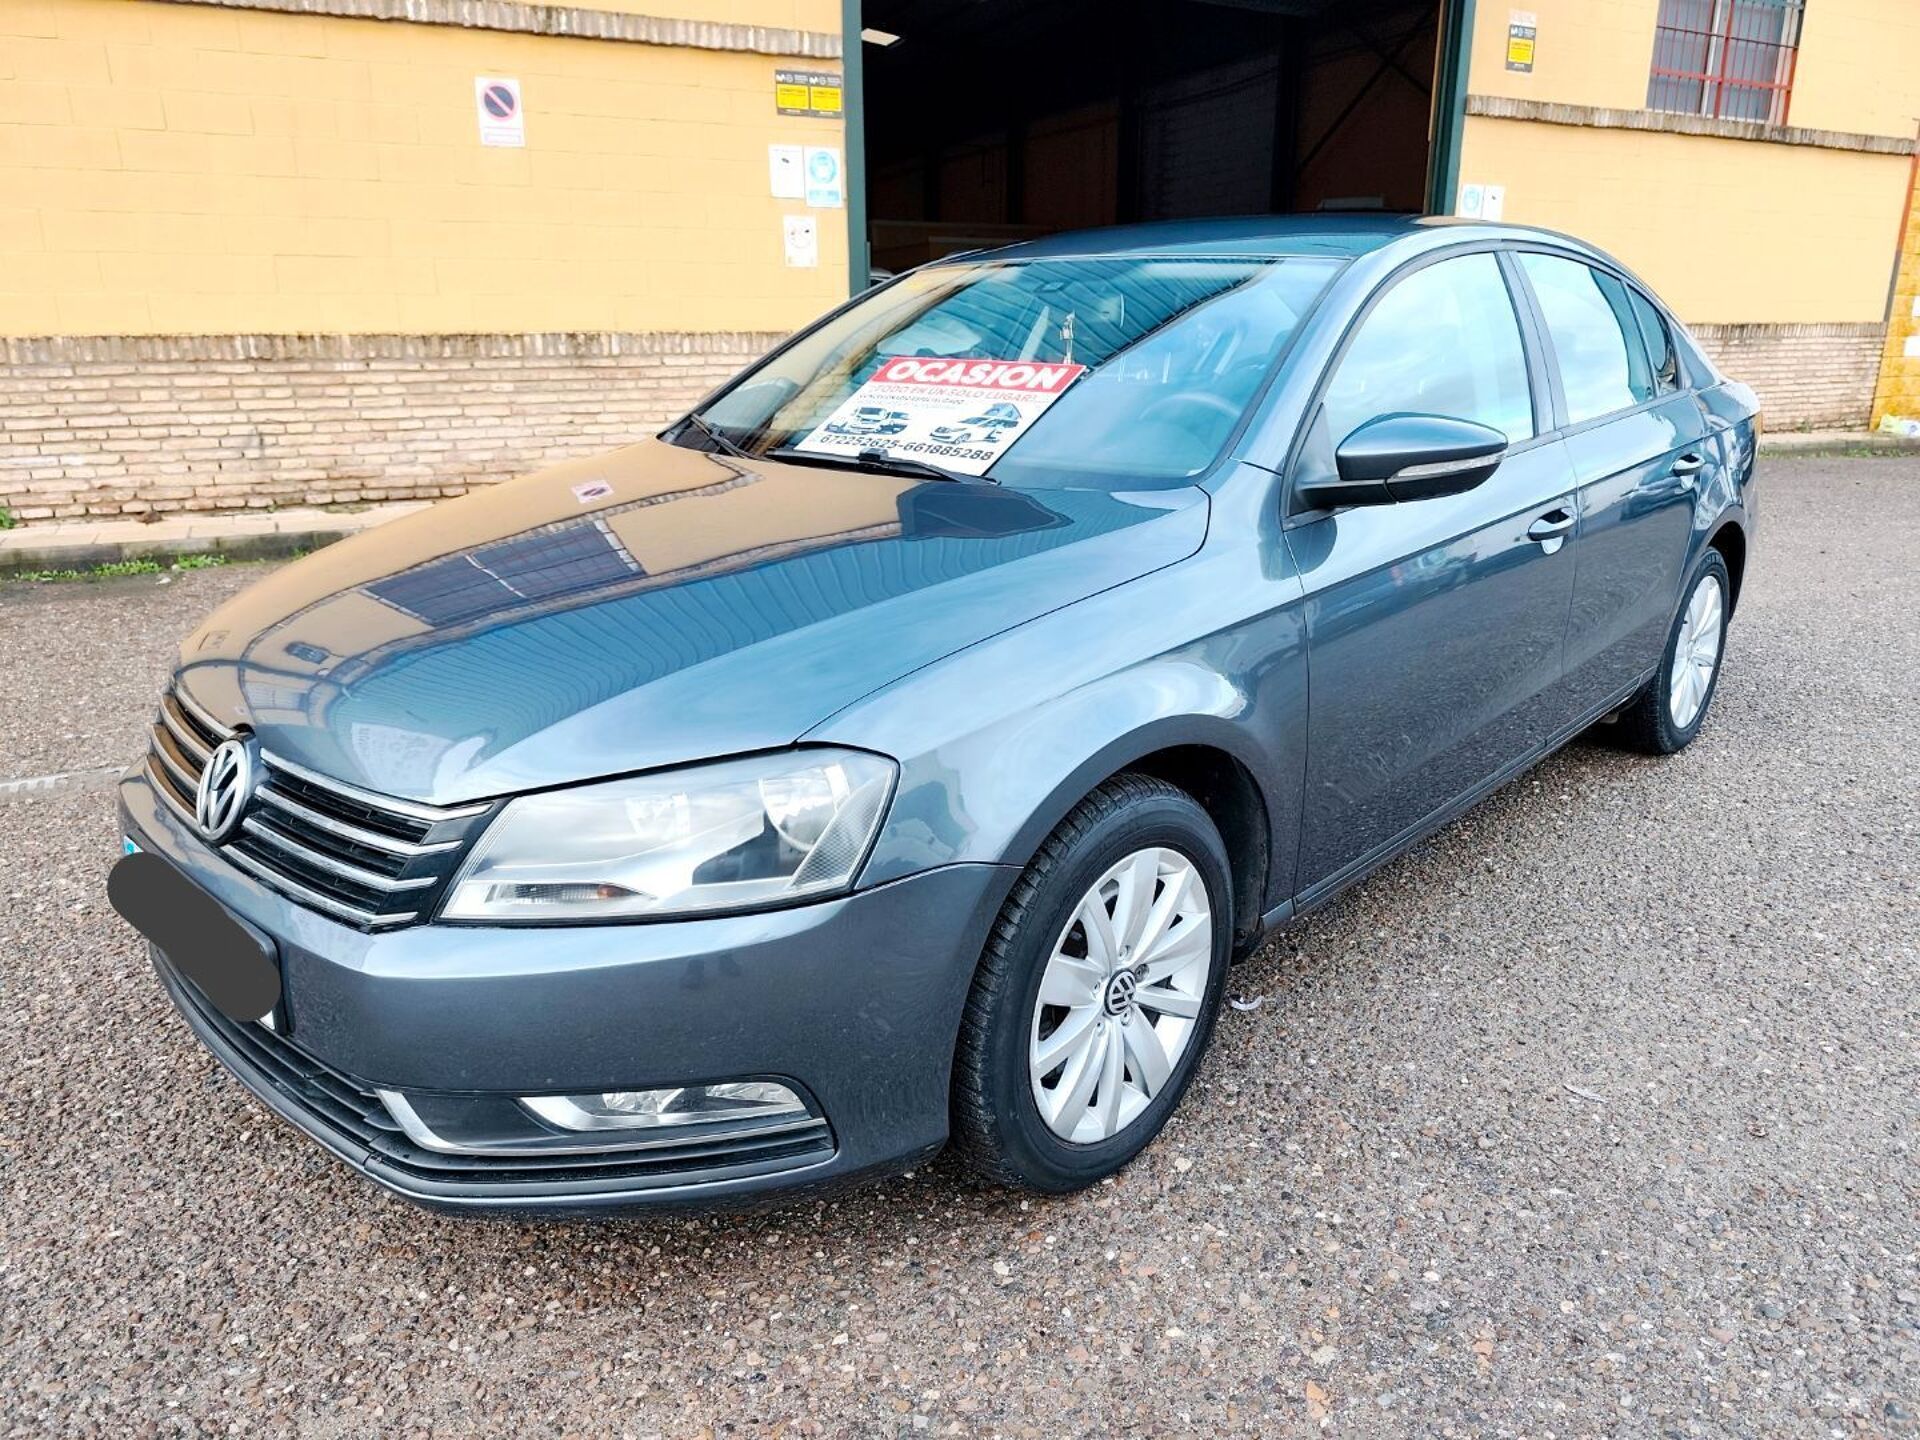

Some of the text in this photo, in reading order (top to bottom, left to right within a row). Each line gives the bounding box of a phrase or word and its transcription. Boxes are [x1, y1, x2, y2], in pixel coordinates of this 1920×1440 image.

[886, 360, 1068, 389] OCASION
[928, 387, 946, 397] UN
[947, 388, 985, 398] SOLO
